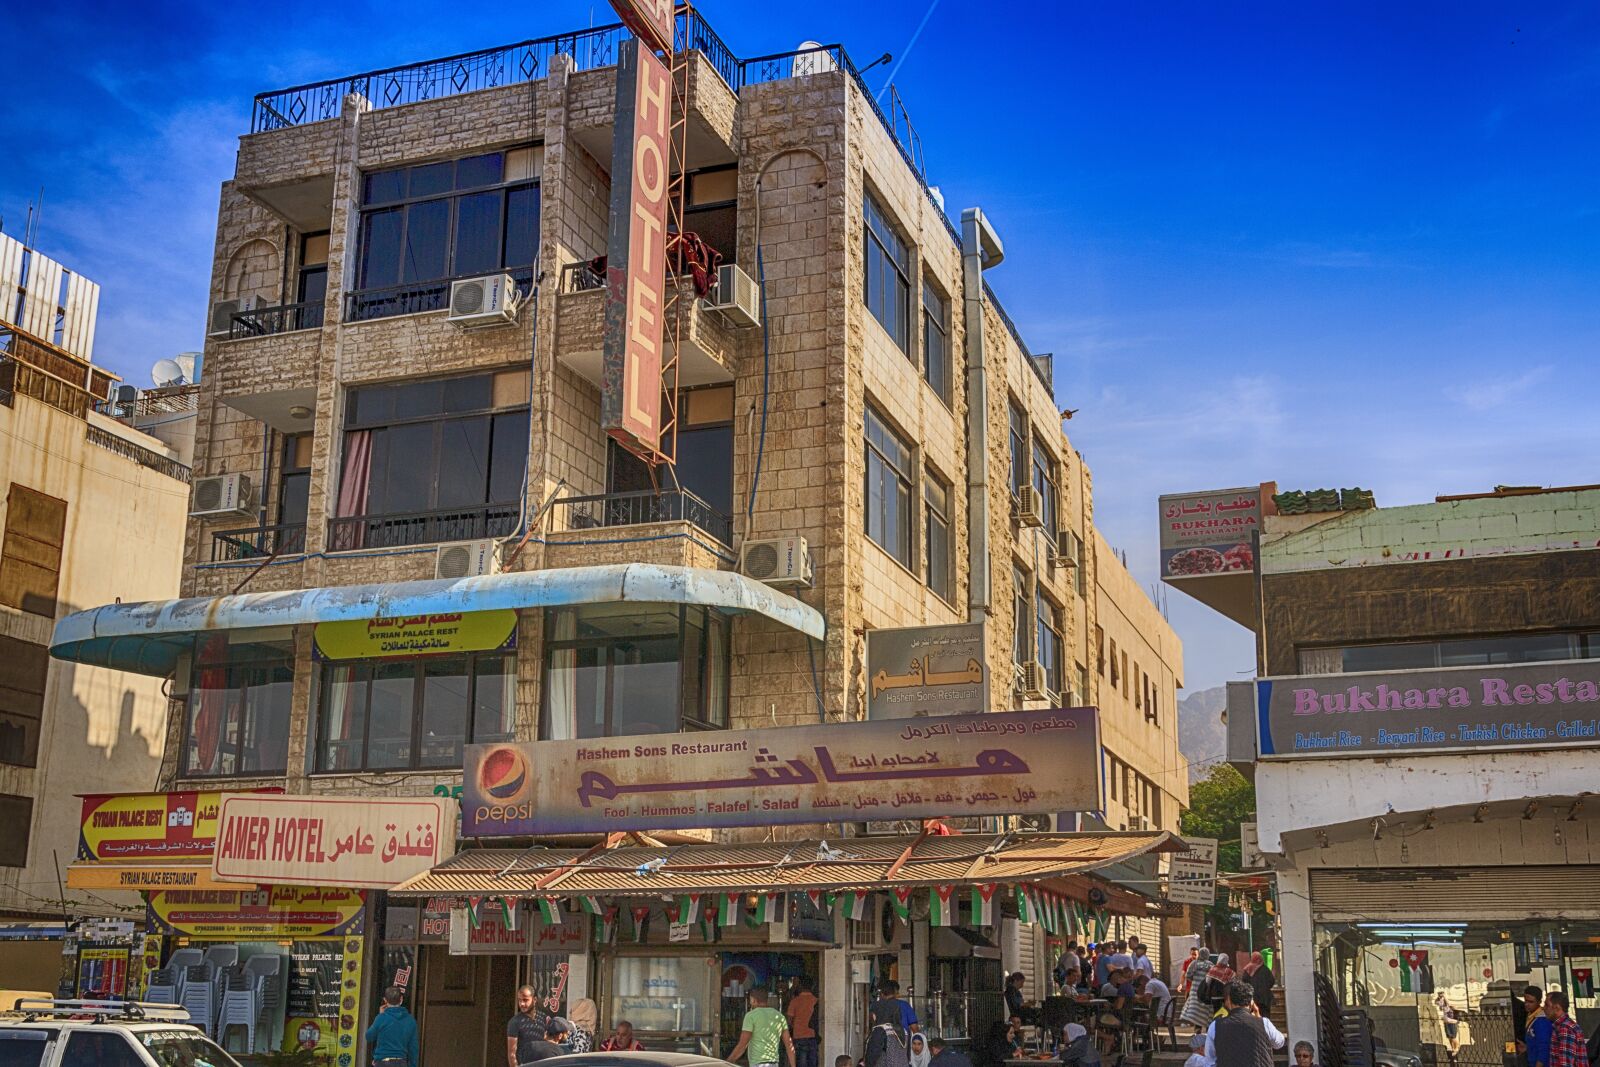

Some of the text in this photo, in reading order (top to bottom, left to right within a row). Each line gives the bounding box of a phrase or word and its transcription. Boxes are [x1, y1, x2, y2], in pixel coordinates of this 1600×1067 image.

[629, 58, 667, 429] HOTEL
[1215, 496, 1256, 514] مطعم
[1171, 516, 1256, 530] BUKHARA
[1181, 527, 1244, 536] RESTAURANT
[369, 627, 458, 640] SYRIAN PALACE REST
[872, 654, 984, 700] هاشم
[887, 688, 978, 703] Hashem Sons Restaurant
[1292, 677, 1600, 716] Bukhara Resta
[900, 724, 951, 741] الكرمل
[1030, 717, 1077, 732] مطعم
[1295, 731, 1337, 750] Bukhari
[1339, 730, 1362, 747] Rice
[1421, 726, 1445, 743] Rice
[1458, 723, 1498, 741] Turkish
[1501, 722, 1548, 740] Chicken
[1556, 720, 1596, 737] Grilled
[577, 740, 748, 761] Hashem Sons Restaurant
[577, 746, 1032, 808] هاشم
[968, 790, 999, 805] حمص
[1012, 788, 1036, 803] فول
[475, 800, 532, 824] pepsi
[604, 797, 800, 818] Fool Hummos Falafel Salad
[93, 809, 164, 828] SYRIAN PALACE REST
[222, 815, 325, 863] AMER HOTEL
[327, 823, 435, 864] فندق عامر
[120, 871, 197, 885] SYRIAN PALACE RESTAURANT
[471, 920, 496, 943] AMER
